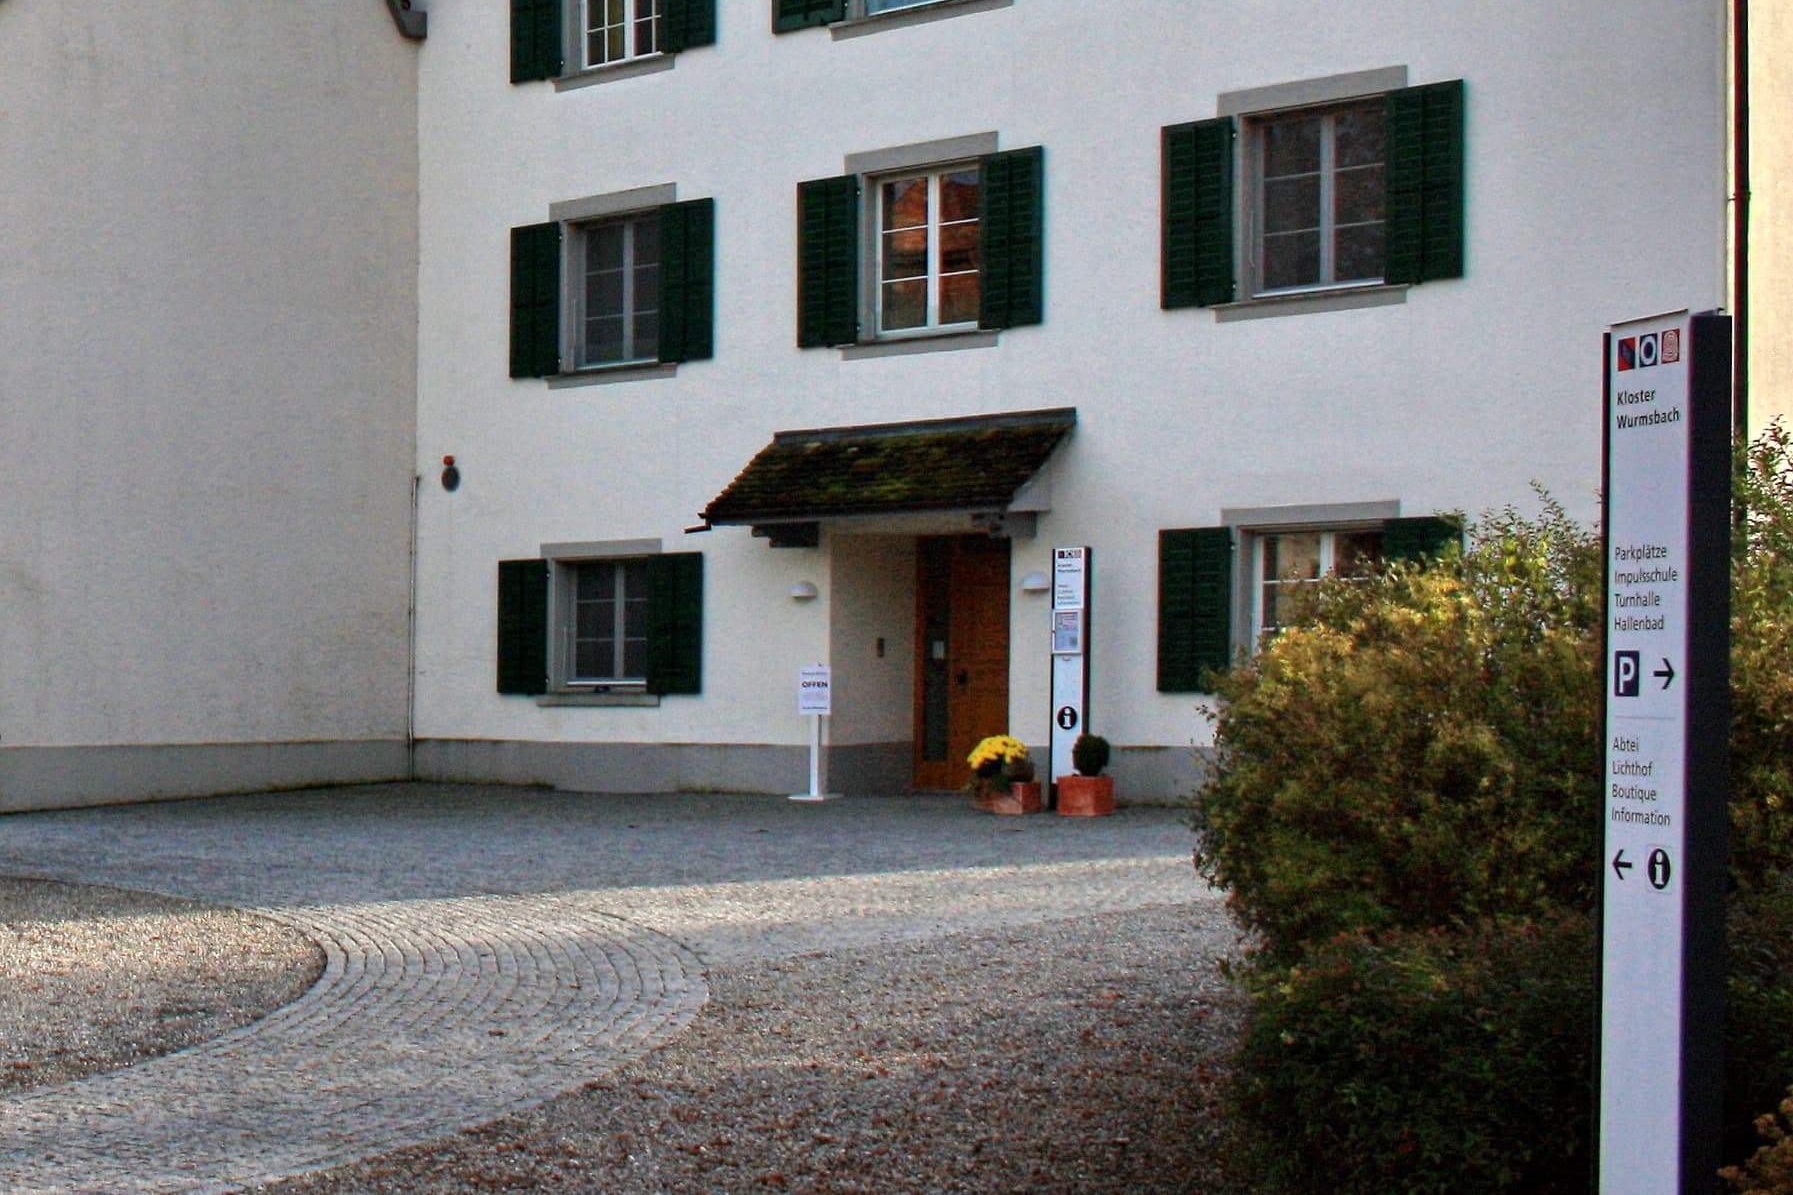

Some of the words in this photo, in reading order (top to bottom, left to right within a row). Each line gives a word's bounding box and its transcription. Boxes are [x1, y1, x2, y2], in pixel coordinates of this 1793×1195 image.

[1617, 389, 1656, 405] Kloster
[1616, 407, 1680, 429] Wurmsbach
[1615, 545, 1667, 562] Parkplätze
[1614, 565, 1678, 587] Impulsschule
[1614, 591, 1660, 607] Turnhalle
[1614, 613, 1664, 631] Hallenbad
[1618, 656, 1635, 694] P
[801, 680, 828, 688] OFFEN
[1612, 736, 1640, 752] Abtei
[1612, 760, 1653, 776] Lichthof
[1611, 783, 1657, 803] Boutique
[1611, 807, 1671, 826] Information
